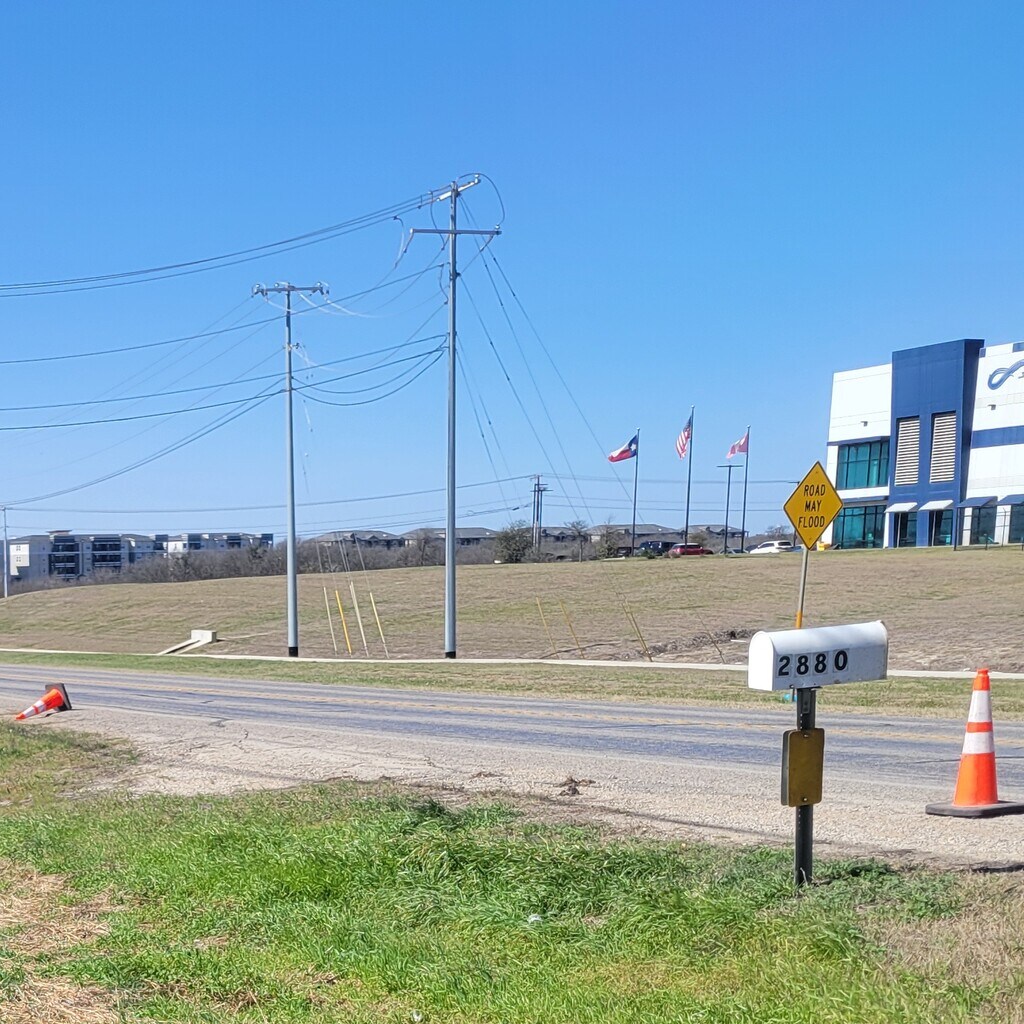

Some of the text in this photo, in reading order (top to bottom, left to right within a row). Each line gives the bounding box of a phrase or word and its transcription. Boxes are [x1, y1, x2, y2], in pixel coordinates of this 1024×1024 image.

[803, 484, 826, 497] ROAD
[804, 500, 822, 512] MAY
[798, 515, 825, 529] FLOOD
[778, 650, 848, 676] 2880
